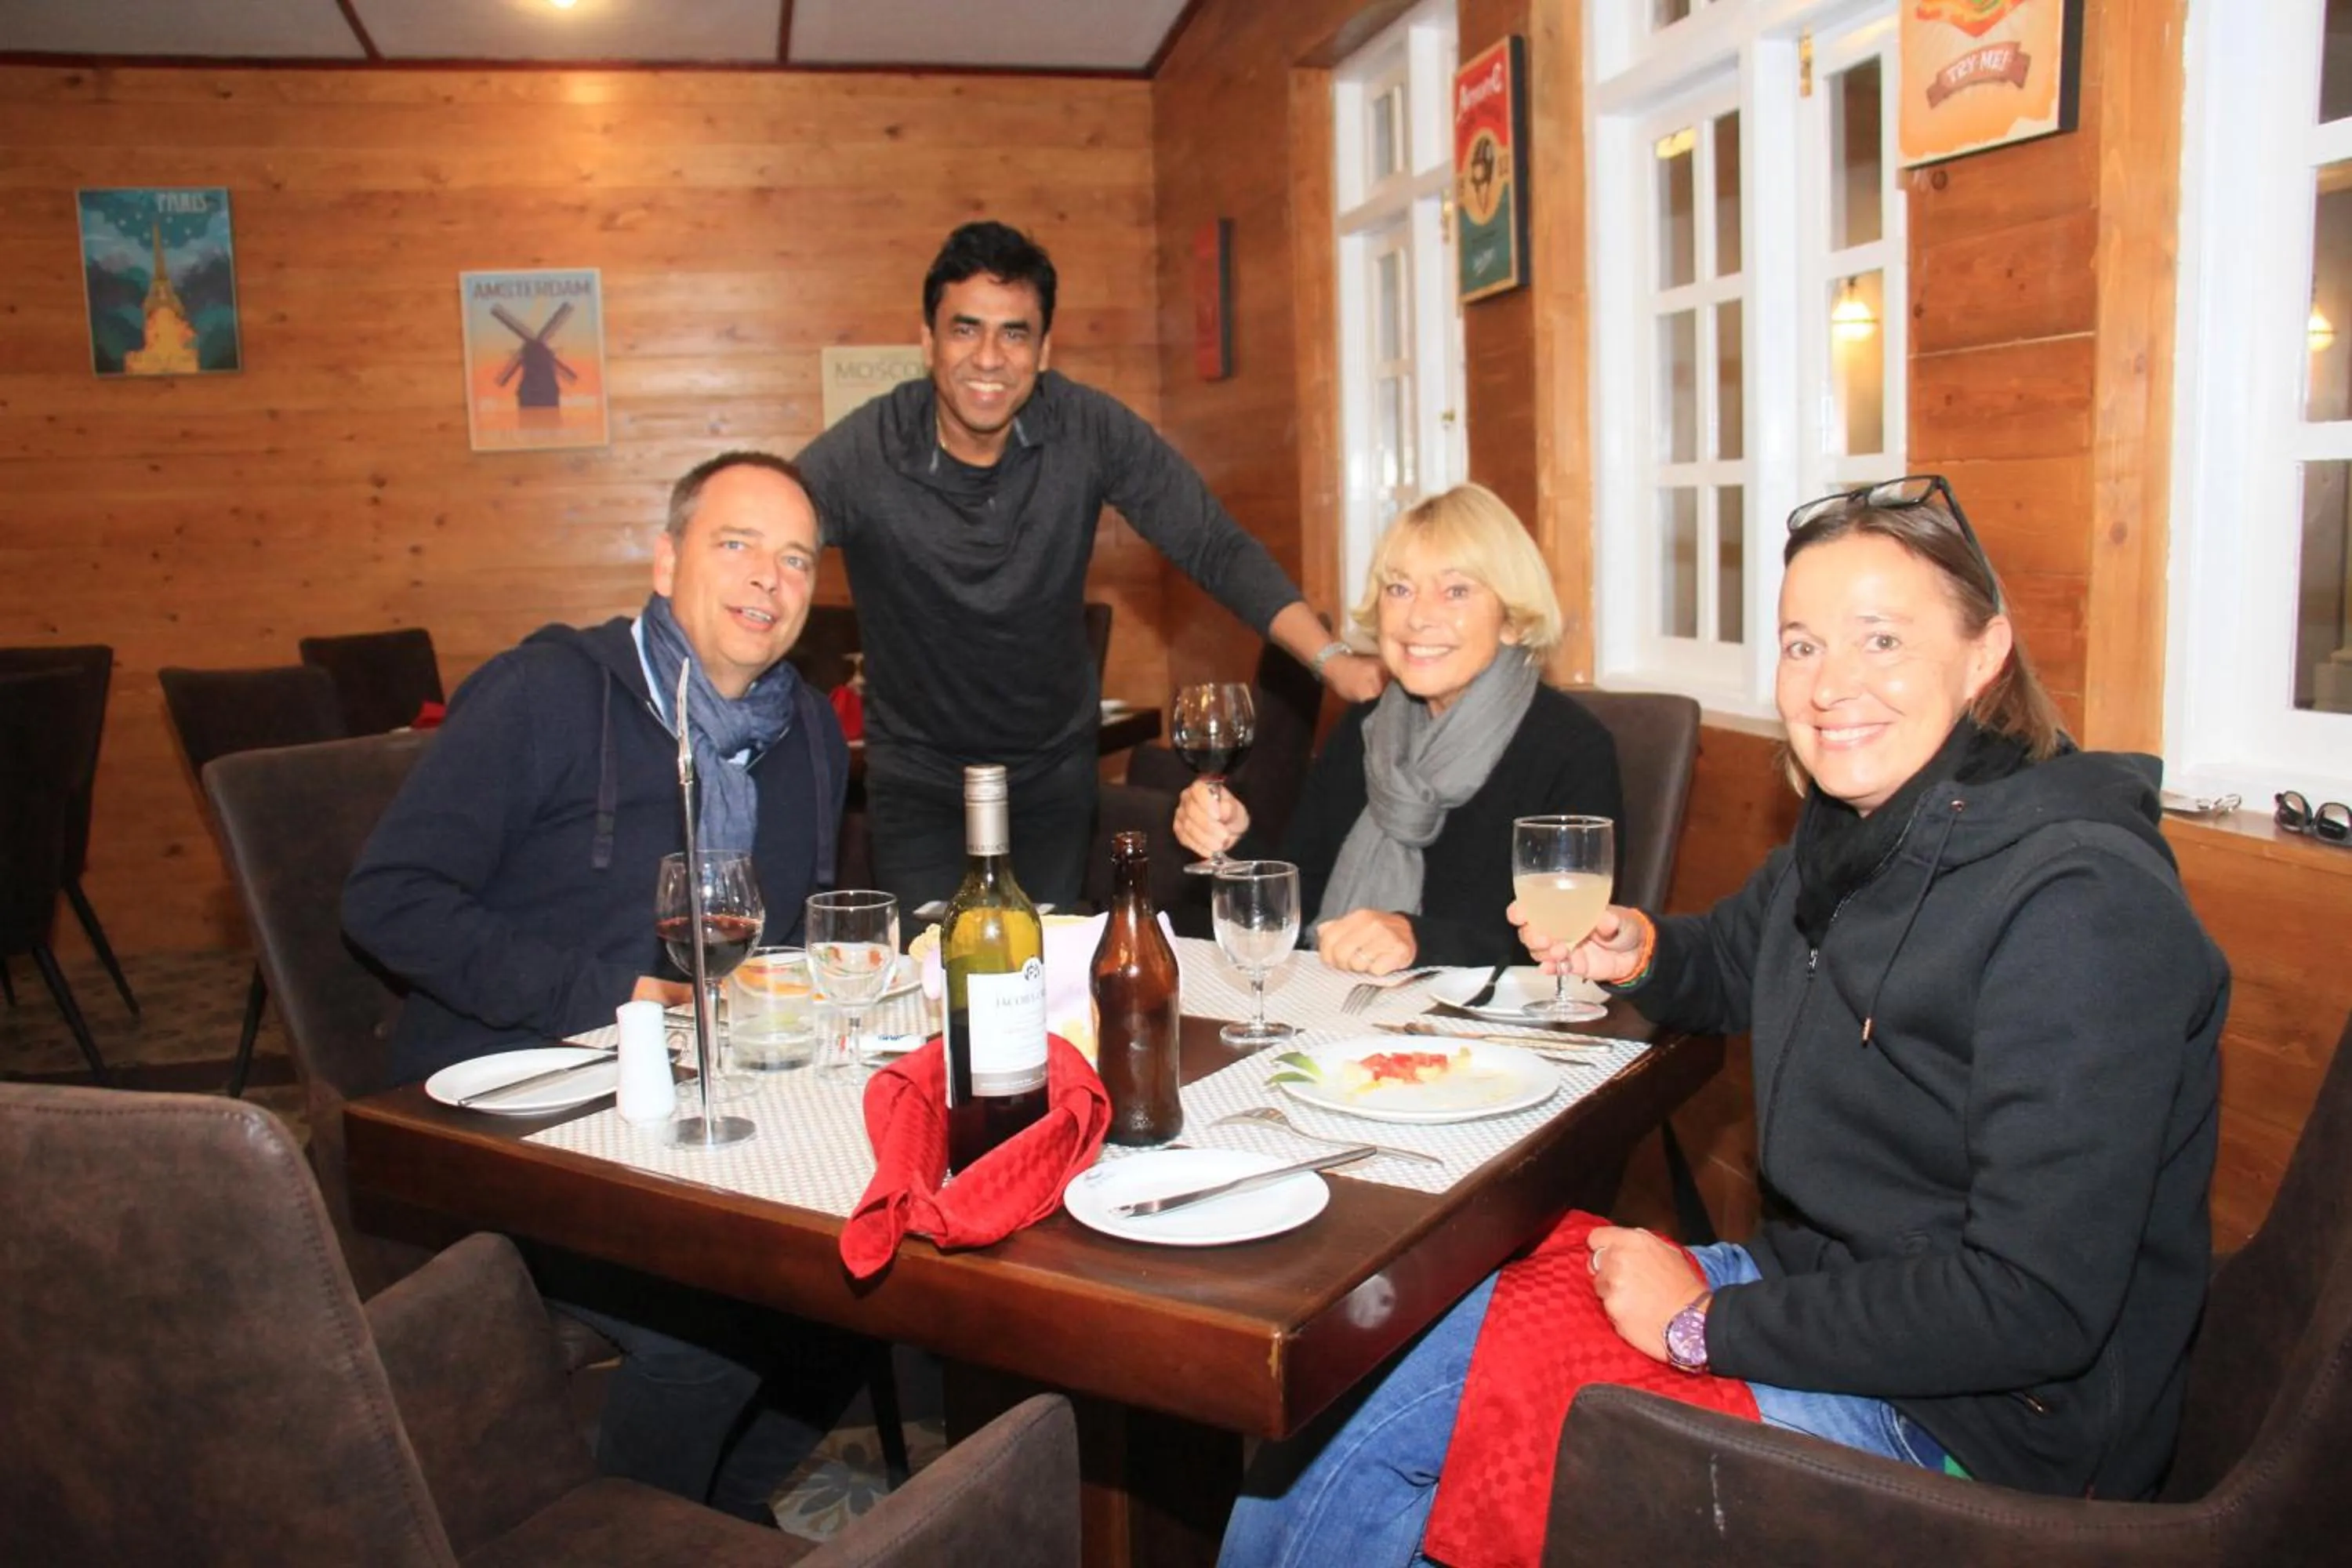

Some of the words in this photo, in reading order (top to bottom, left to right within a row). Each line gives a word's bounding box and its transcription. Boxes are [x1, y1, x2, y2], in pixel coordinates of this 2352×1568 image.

[1946, 53, 1976, 84] TRY
[1980, 49, 2009, 72] ME!
[157, 192, 207, 213] PARIS
[474, 279, 591, 299] AMSTERDAM
[835, 360, 925, 379] MOSCO
